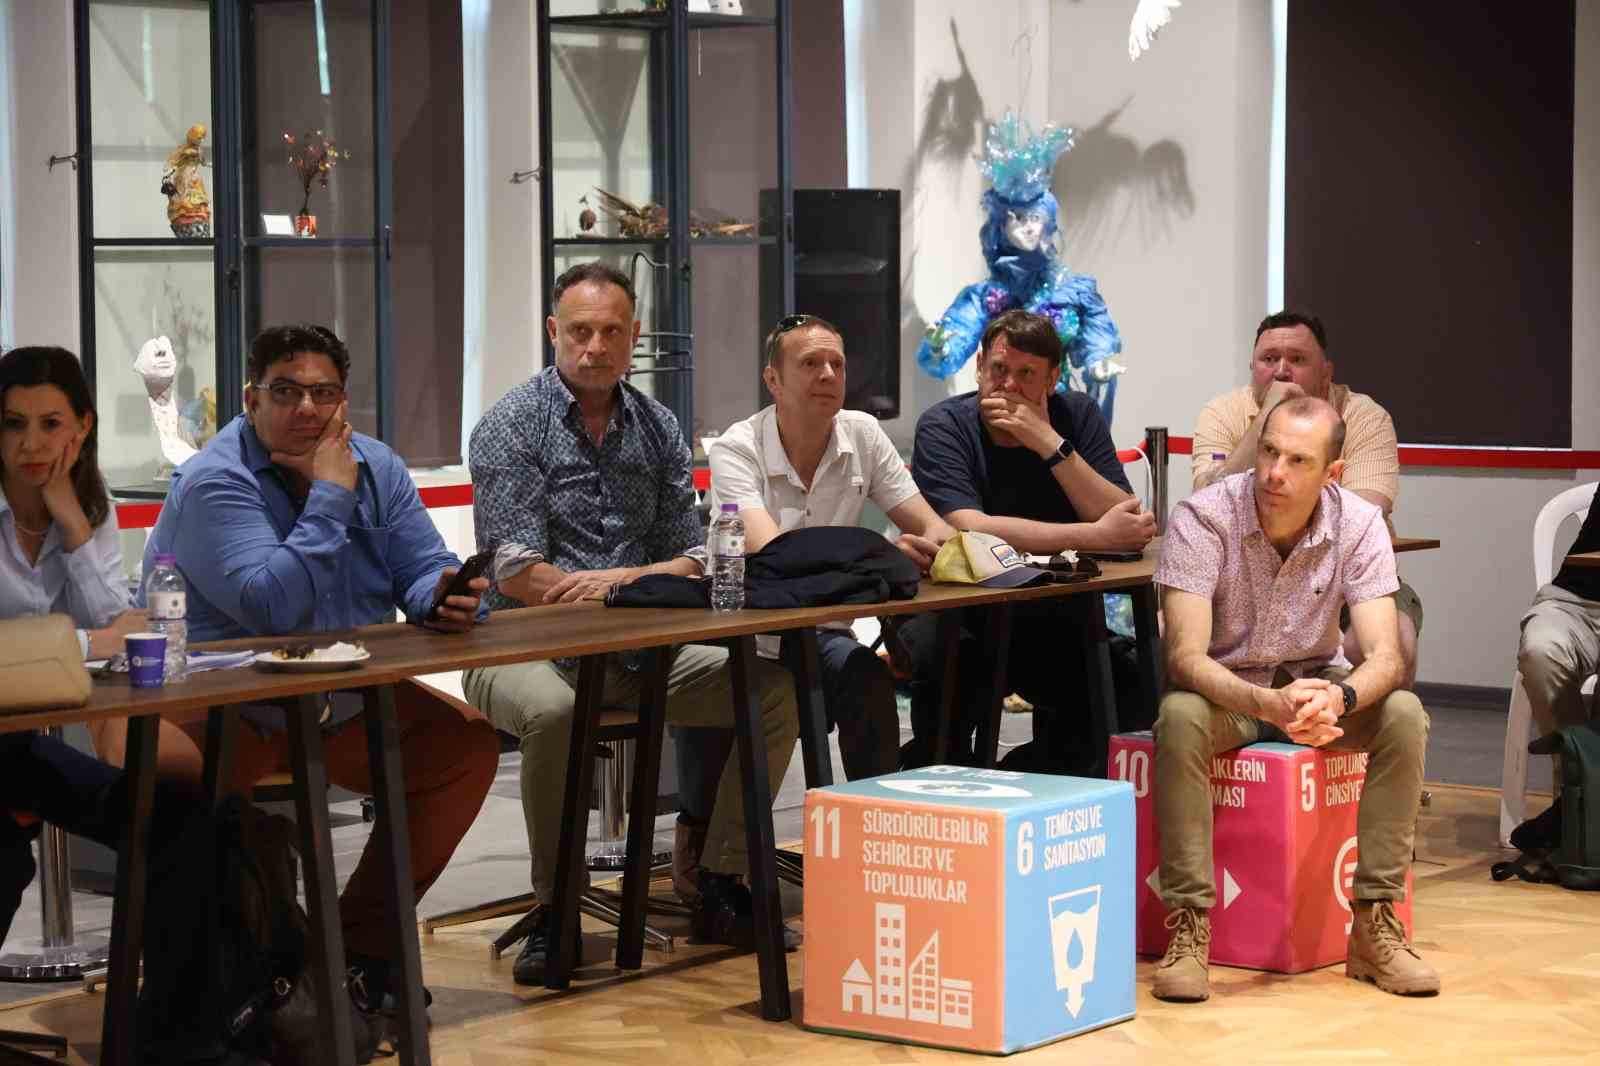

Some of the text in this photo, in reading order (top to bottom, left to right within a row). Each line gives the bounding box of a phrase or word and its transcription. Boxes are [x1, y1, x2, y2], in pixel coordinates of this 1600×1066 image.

[1115, 749, 1149, 798] 10
[1301, 762, 1316, 812] 5
[810, 805, 841, 859] 11
[1089, 804, 1103, 829] VE
[935, 848, 957, 873] VE
[1017, 821, 1033, 875] 6
[863, 869, 967, 904] TOPLULUKLAR
